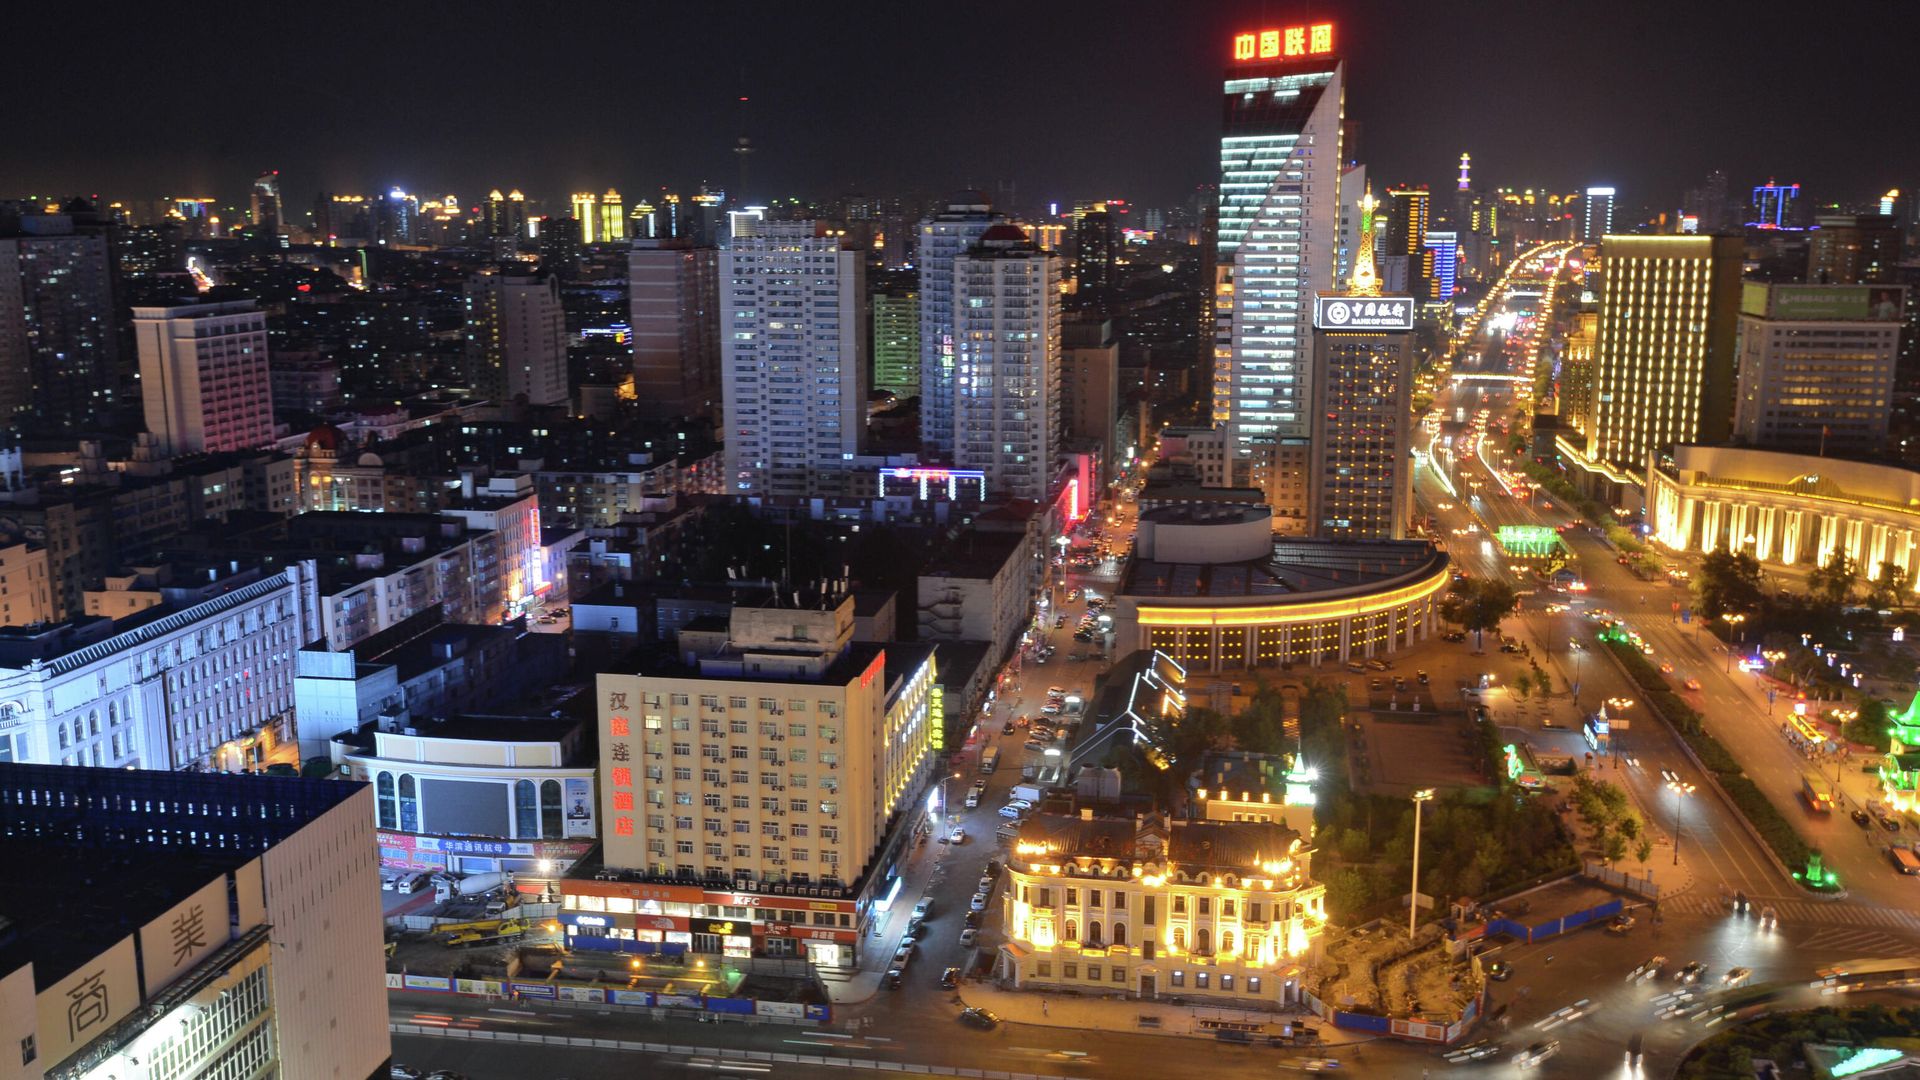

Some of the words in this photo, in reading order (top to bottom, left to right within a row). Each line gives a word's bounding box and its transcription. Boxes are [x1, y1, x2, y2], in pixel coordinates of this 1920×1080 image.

[1235, 24, 1332, 60] 中国联通
[1352, 302, 1405, 317] 中国银行
[610, 692, 634, 836] 汉庭连锁酒店
[733, 896, 760, 906] KFC
